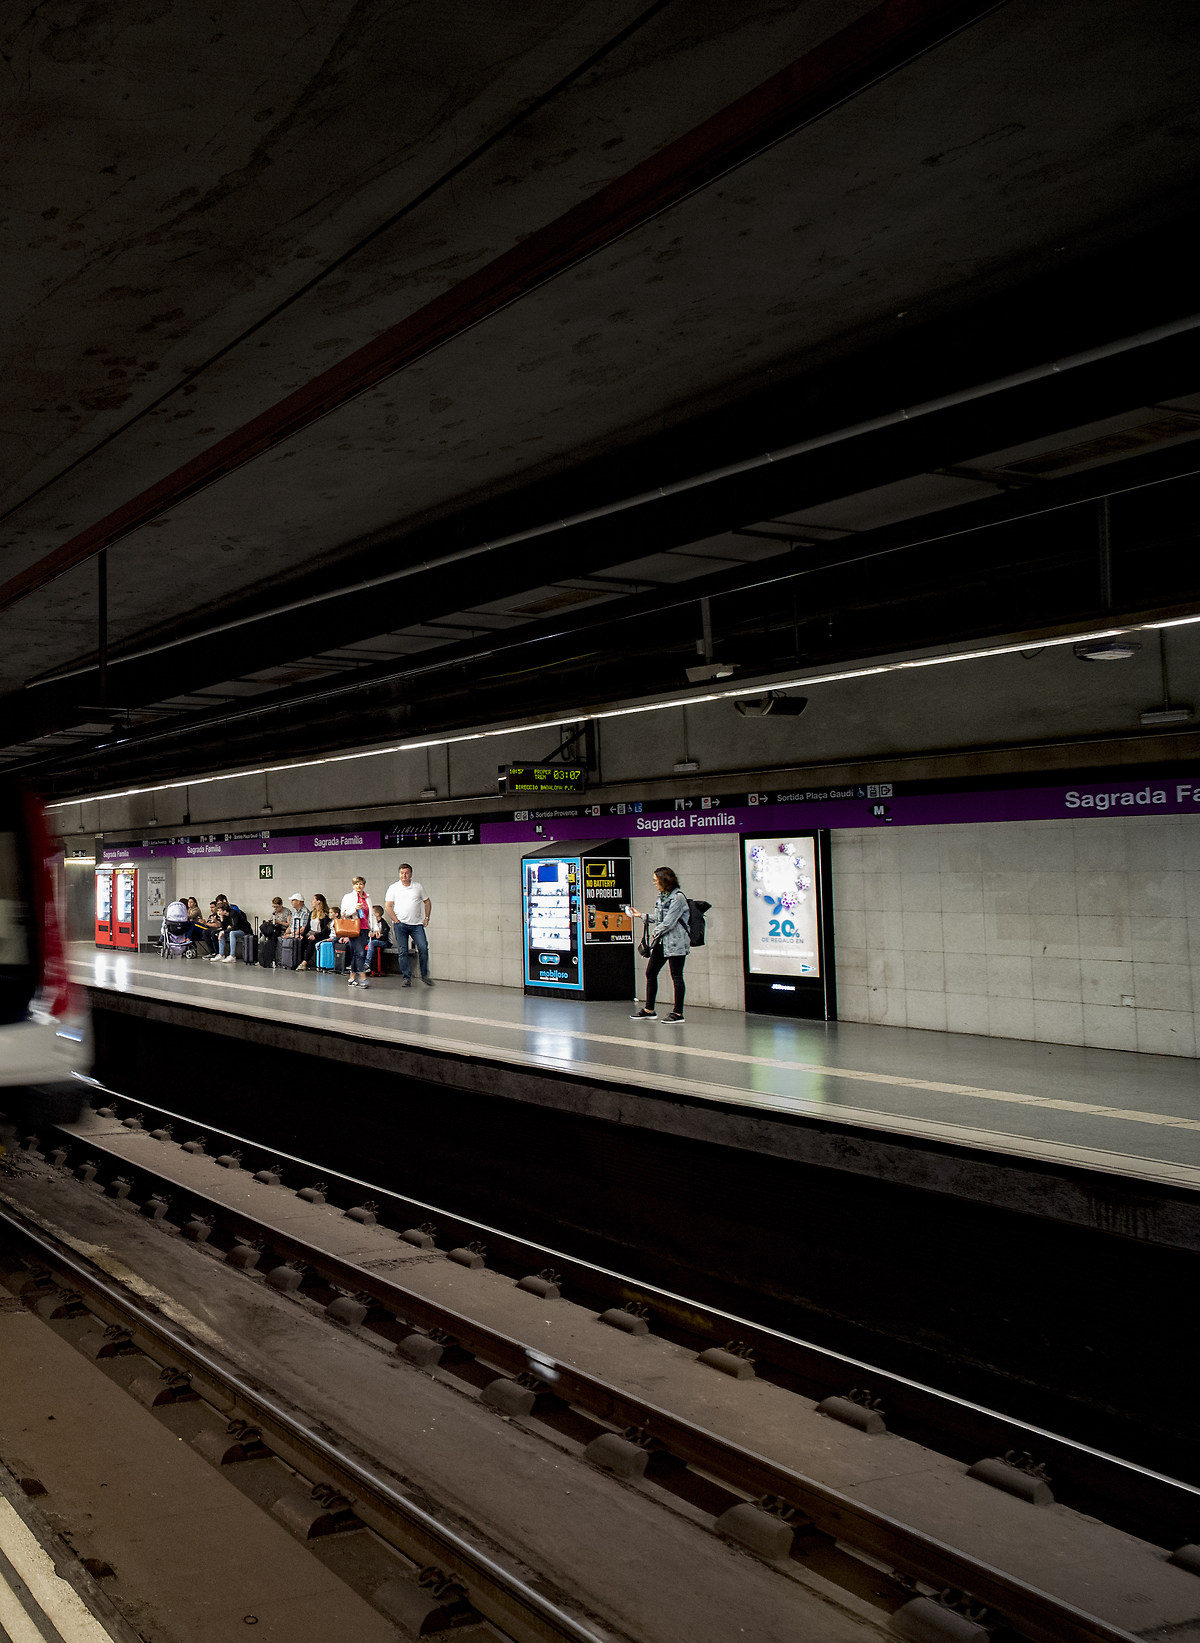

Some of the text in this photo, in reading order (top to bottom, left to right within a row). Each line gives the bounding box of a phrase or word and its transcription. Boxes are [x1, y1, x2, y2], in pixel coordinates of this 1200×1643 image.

[553, 770, 581, 780] 03:07
[776, 789, 854, 802] Sortida Plaça Gaudí
[1064, 786, 1167, 811] Sagrada
[554, 809, 578, 818] Provença
[873, 805, 885, 816] M
[636, 812, 736, 832] Sagrada Família
[314, 835, 363, 849] Sagrada Família
[187, 845, 205, 854] Sagrada
[593, 880, 616, 888] BATTERY?
[586, 888, 623, 898] NO PROBLEM
[768, 919, 800, 938] 20%
